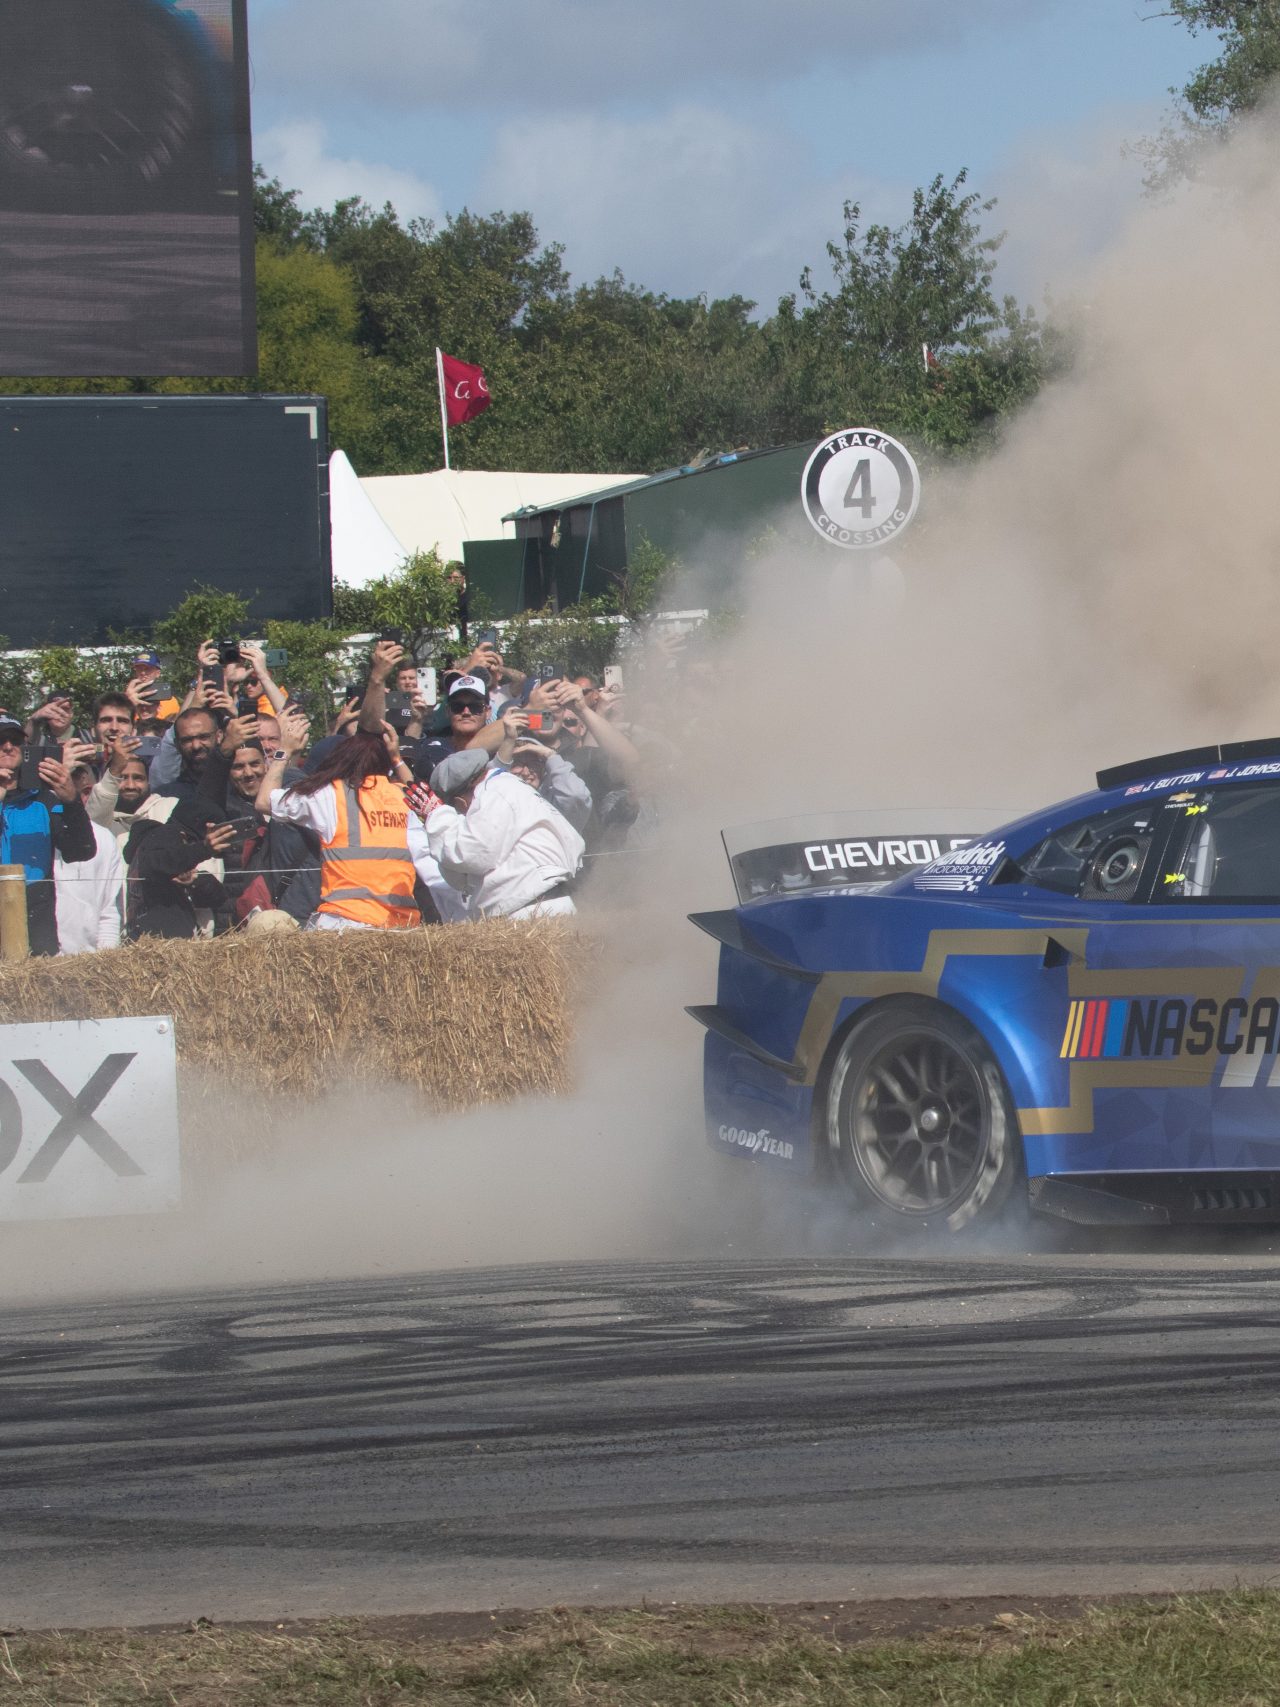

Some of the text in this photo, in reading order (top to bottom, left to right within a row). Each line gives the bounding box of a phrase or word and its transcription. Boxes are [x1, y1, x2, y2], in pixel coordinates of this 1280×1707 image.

[824, 433, 891, 456] TRACK
[843, 458, 877, 519] 4
[817, 508, 906, 545] CROSSING
[1153, 771, 1206, 790] BUTTON
[369, 810, 407, 829] STEWAR
[929, 865, 991, 875] MOTORSPORTS
[0, 1052, 147, 1184] X
[718, 1124, 794, 1160] GOODYEAR
